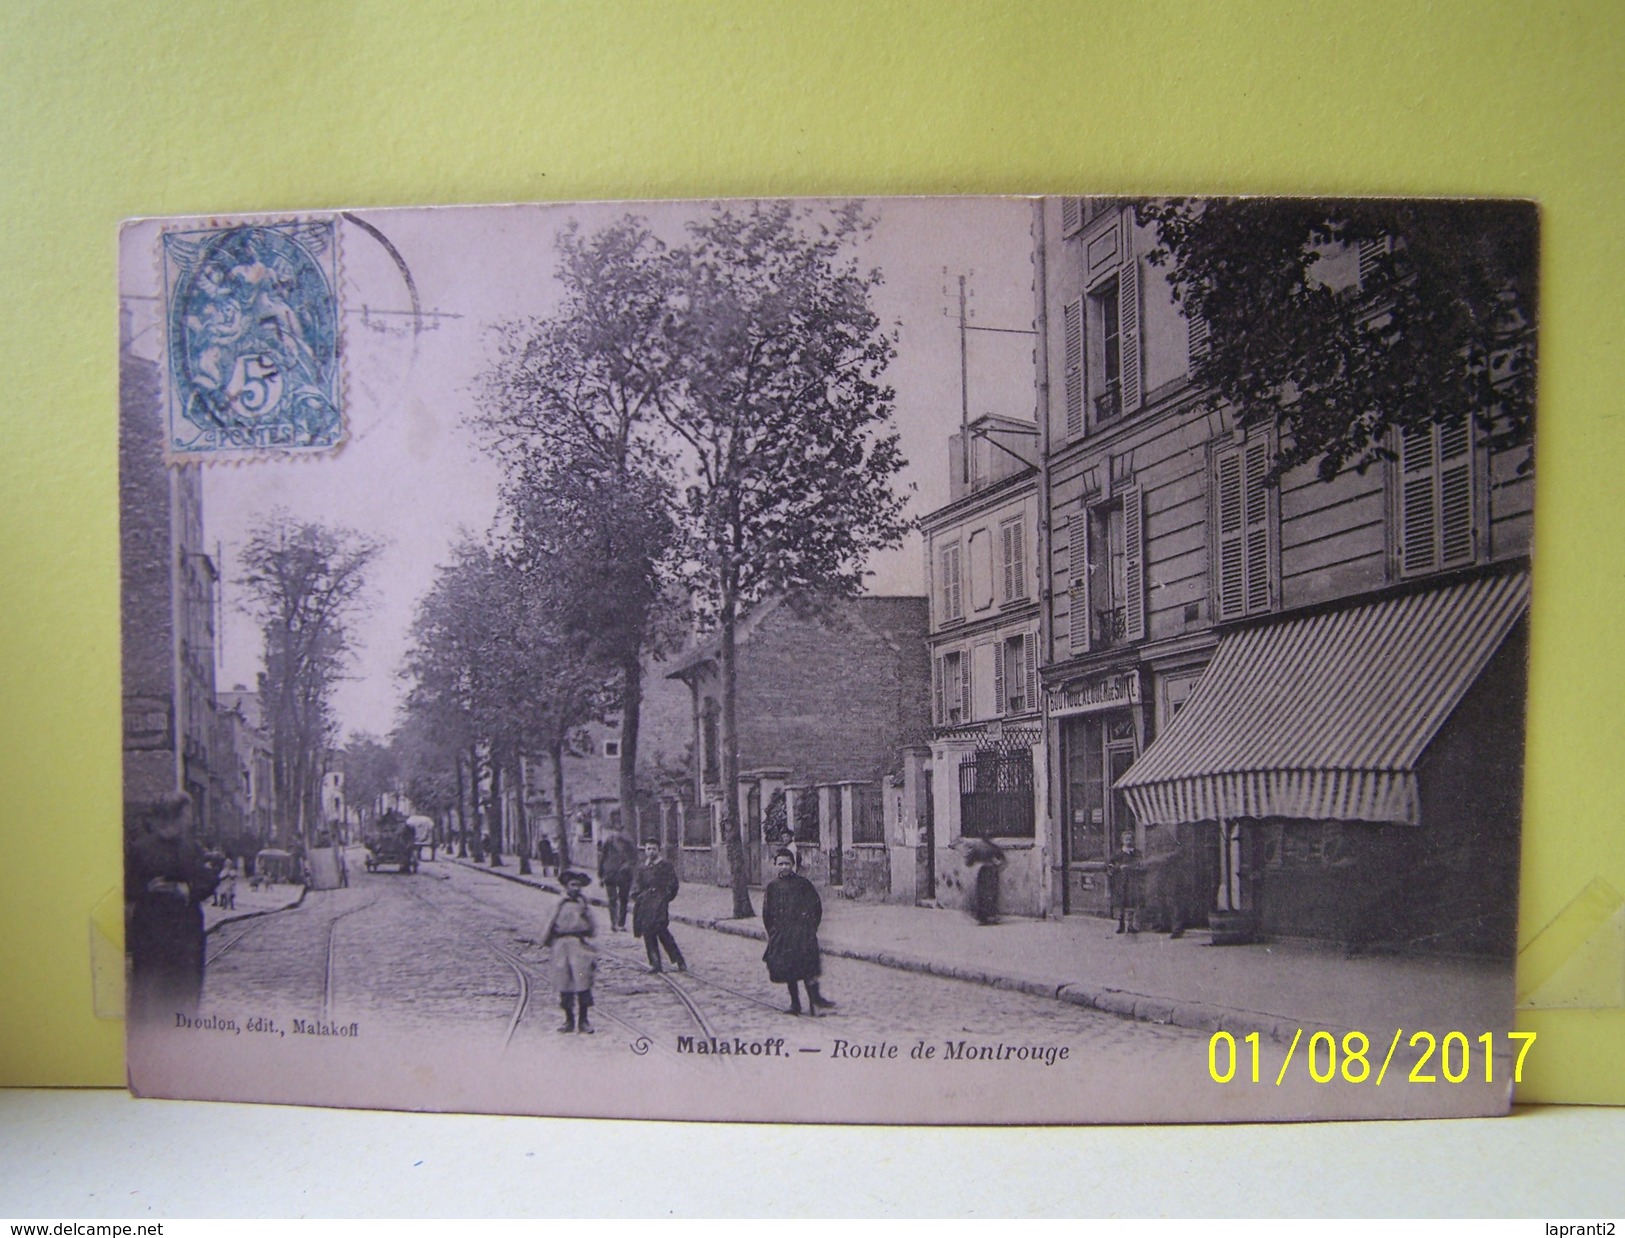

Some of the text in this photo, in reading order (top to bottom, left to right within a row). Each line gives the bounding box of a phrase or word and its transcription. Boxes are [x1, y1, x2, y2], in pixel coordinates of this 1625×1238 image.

[238, 356, 275, 410] 5
[219, 427, 292, 446] POSTES
[246, 1018, 285, 1038] édit.,
[292, 1019, 360, 1037] Malakoff
[676, 1036, 790, 1058] Malakoff.
[830, 1039, 898, 1060] Route
[911, 1041, 935, 1059] de
[944, 1041, 1070, 1066] Montrouge
